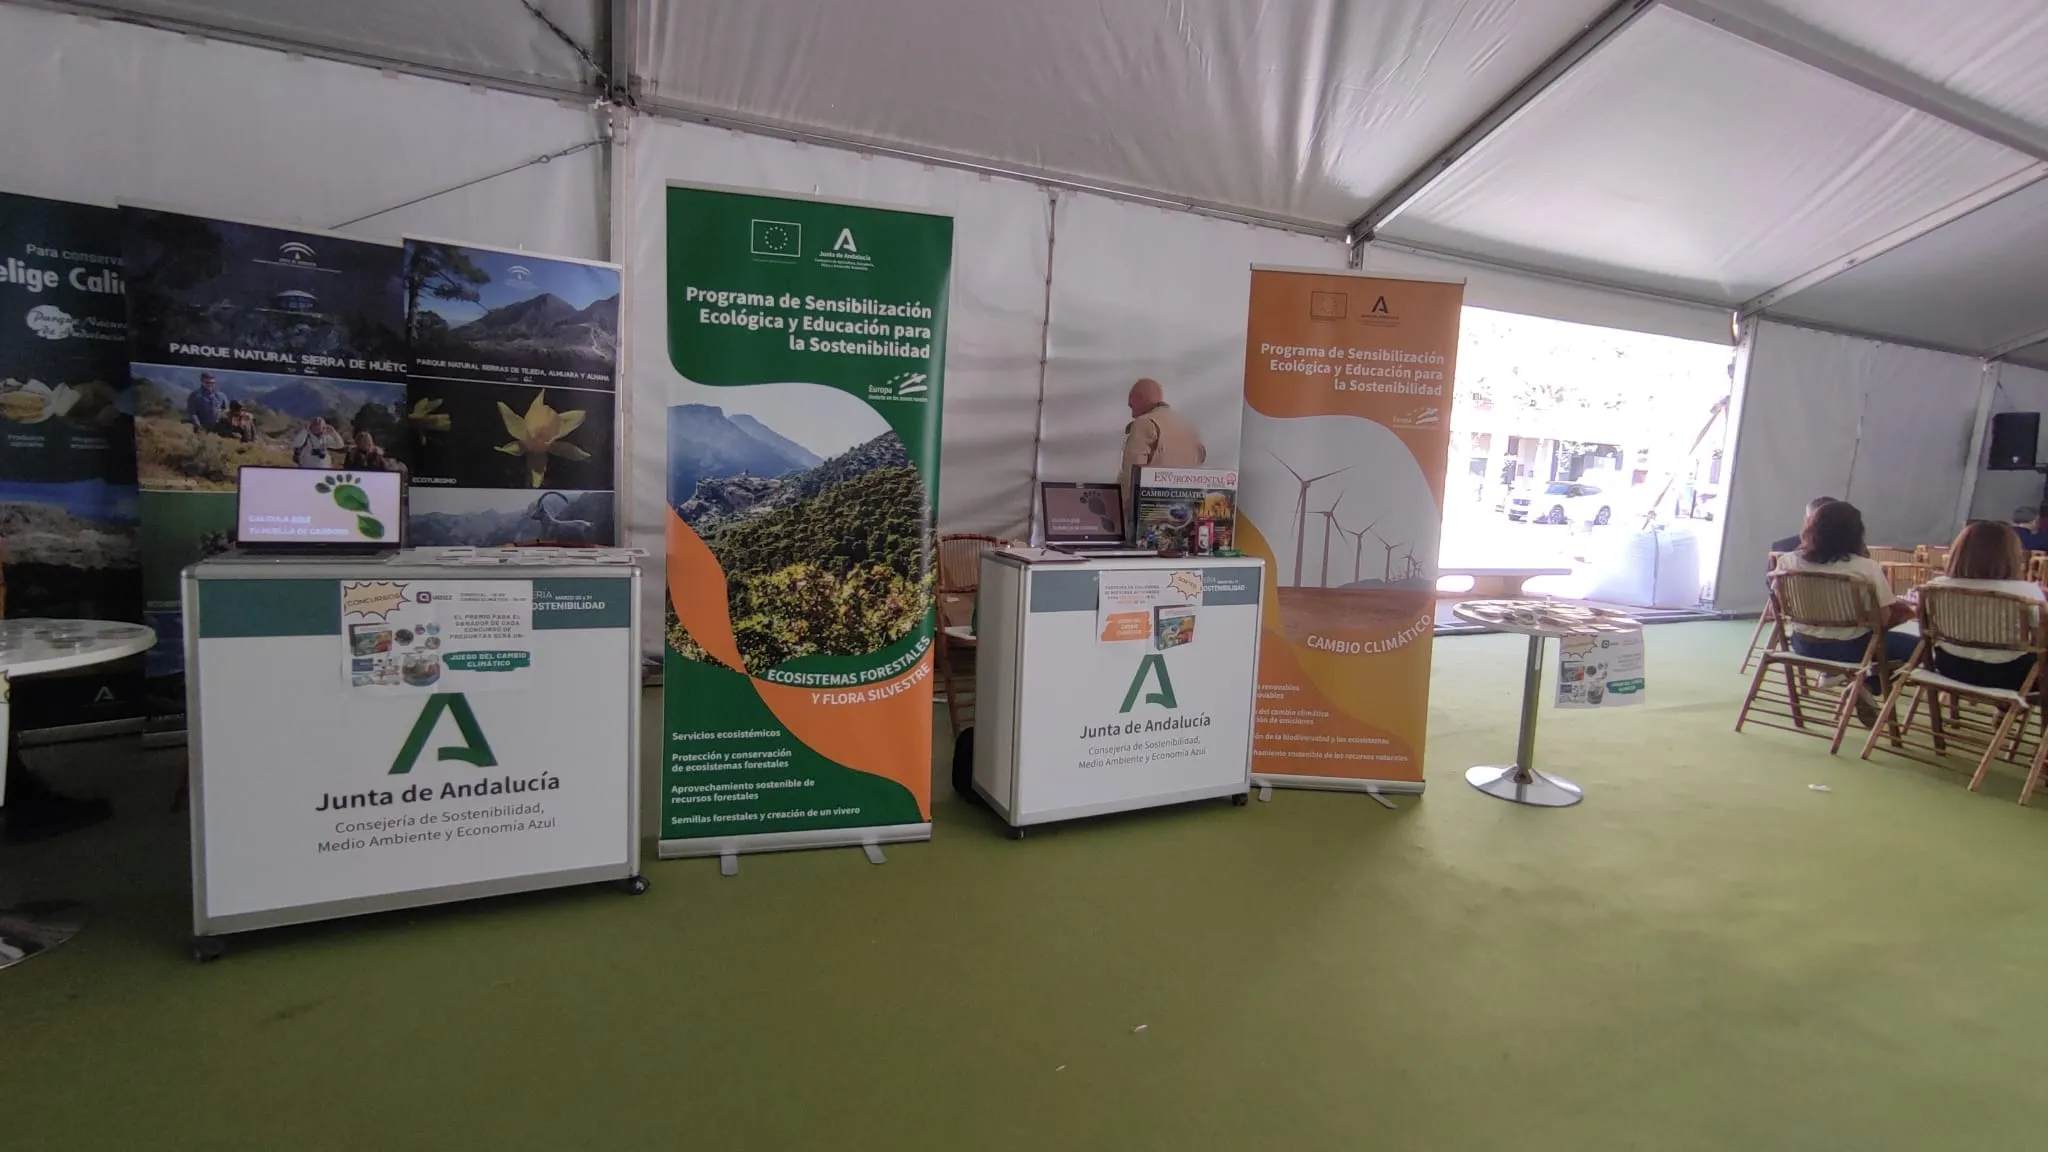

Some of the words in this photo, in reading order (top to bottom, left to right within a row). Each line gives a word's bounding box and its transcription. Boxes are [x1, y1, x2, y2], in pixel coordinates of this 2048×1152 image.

[26, 243, 58, 258] Para
[686, 286, 774, 309] Programa
[779, 292, 800, 308] de
[805, 295, 932, 319] Sensibilización
[699, 308, 783, 331] Ecológica
[788, 317, 798, 332] y
[803, 316, 890, 336] Educación
[894, 324, 931, 340] para
[169, 343, 230, 358] PARQUE
[234, 348, 297, 364] NATURAL
[301, 354, 345, 368] SIERRA
[350, 358, 366, 370] DE
[789, 335, 804, 350] la
[809, 337, 930, 359] Sostenibilidad
[1261, 343, 1325, 359] Programa
[1328, 346, 1344, 358] de
[1348, 348, 1444, 365] Sensibilización
[416, 358, 446, 368] PARQUE
[448, 361, 480, 371] NATURAL
[482, 363, 510, 373] SIERRAS
[510, 366, 520, 374] DE
[1270, 358, 1331, 376] Ecológica
[1334, 366, 1342, 377] y
[1345, 363, 1411, 379] Educación
[1414, 370, 1443, 384] para
[868, 384, 892, 395] Europa
[1335, 378, 1346, 391] la
[1349, 380, 1442, 396] Sostenibilidad
[1141, 489, 1169, 497] CAMBIO
[1307, 635, 1361, 654] CAMBIO
[1364, 615, 1432, 653] CLIMÁTICO
[767, 668, 857, 686] ECOSISTEMAS
[860, 635, 931, 683] FORESTALES
[811, 692, 821, 704] Y
[822, 692, 866, 705] FLORA
[868, 663, 931, 701] SILVESTRE
[672, 731, 716, 741] Servicios
[717, 728, 781, 739] ecosistémicos
[1080, 725, 1120, 739] Junta
[1125, 721, 1141, 734] de
[1145, 712, 1211, 732] Andalucía
[671, 751, 722, 762] Protección
[724, 753, 730, 762] y
[731, 748, 792, 760] conservación
[1089, 743, 1131, 756] Consejería
[1133, 742, 1142, 751] de
[1144, 736, 1201, 750] Sostenibilidad,
[671, 764, 684, 773] de
[685, 761, 743, 771] ecosistemas
[744, 758, 789, 769] forestales
[1078, 758, 1103, 769] Medio
[1105, 754, 1144, 767] Ambiente
[1145, 756, 1150, 764] y
[1151, 749, 1189, 761] Economía
[1190, 747, 1207, 757] Azul
[315, 792, 393, 812] Junta
[401, 785, 433, 803] de
[439, 771, 560, 800] Andalucía
[671, 781, 754, 794] Aprovechamiento
[755, 778, 802, 790] sostenible
[803, 778, 815, 787] de
[671, 794, 712, 804] recursos
[713, 791, 759, 802] forestales
[335, 812, 416, 834] Consejería
[420, 812, 438, 825] de
[442, 802, 545, 822] Sostenibilidad,
[671, 814, 712, 825] Semillas
[713, 811, 759, 822] forestales
[759, 813, 766, 821] y
[767, 808, 807, 820] creación
[807, 808, 819, 817] de
[820, 808, 833, 817] un
[834, 806, 860, 816] vivero
[318, 837, 365, 853] Medio
[369, 828, 442, 848] Ambiente
[444, 831, 453, 842] y
[457, 820, 525, 838] Economía
[528, 816, 556, 831] Azul
